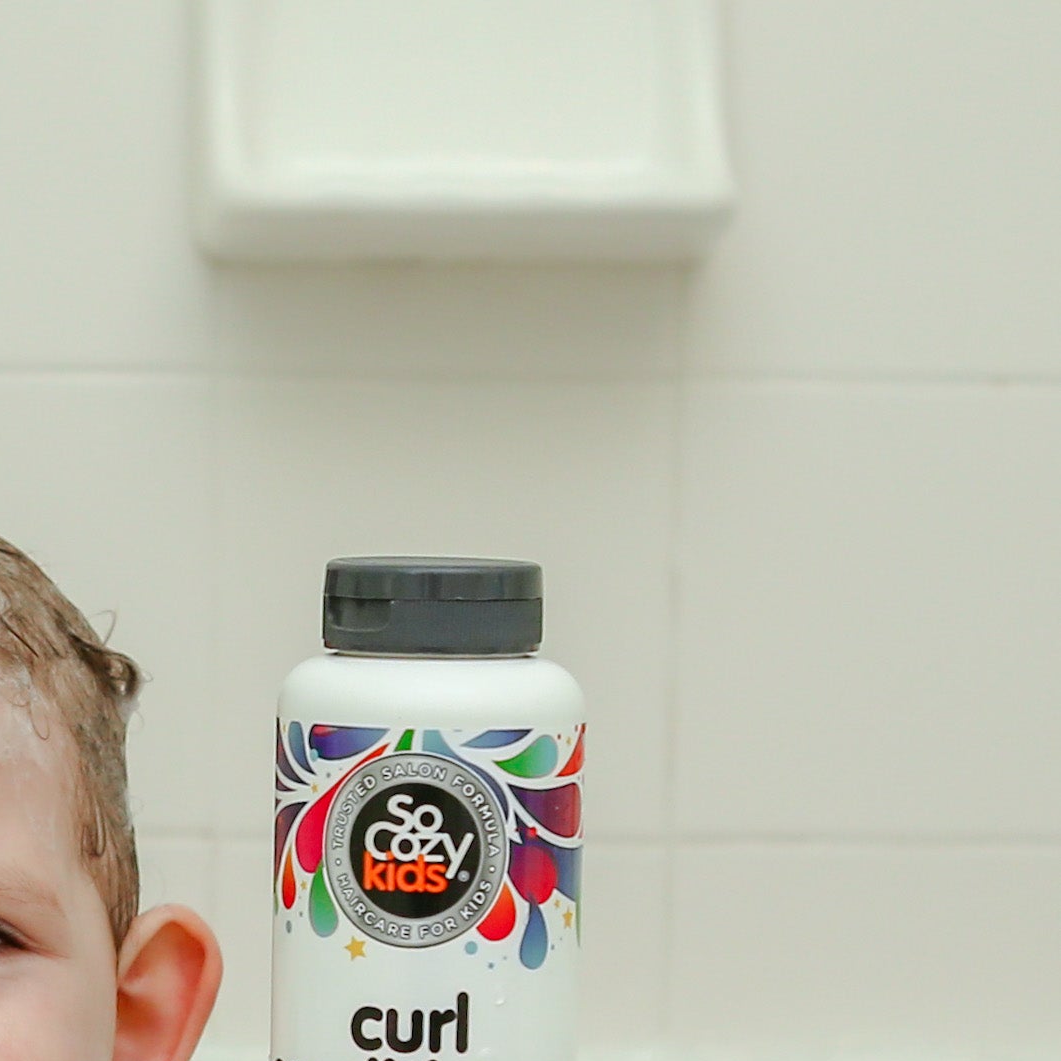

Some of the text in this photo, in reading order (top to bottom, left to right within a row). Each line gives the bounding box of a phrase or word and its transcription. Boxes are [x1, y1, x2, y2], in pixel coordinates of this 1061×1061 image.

[332, 763, 501, 857] TRUSTED SALON FORMULA
[386, 793, 444, 834] So
[362, 850, 449, 894] kids
[338, 873, 492, 939] HAIRCARE FOR KIDS
[350, 991, 469, 1054] curl
